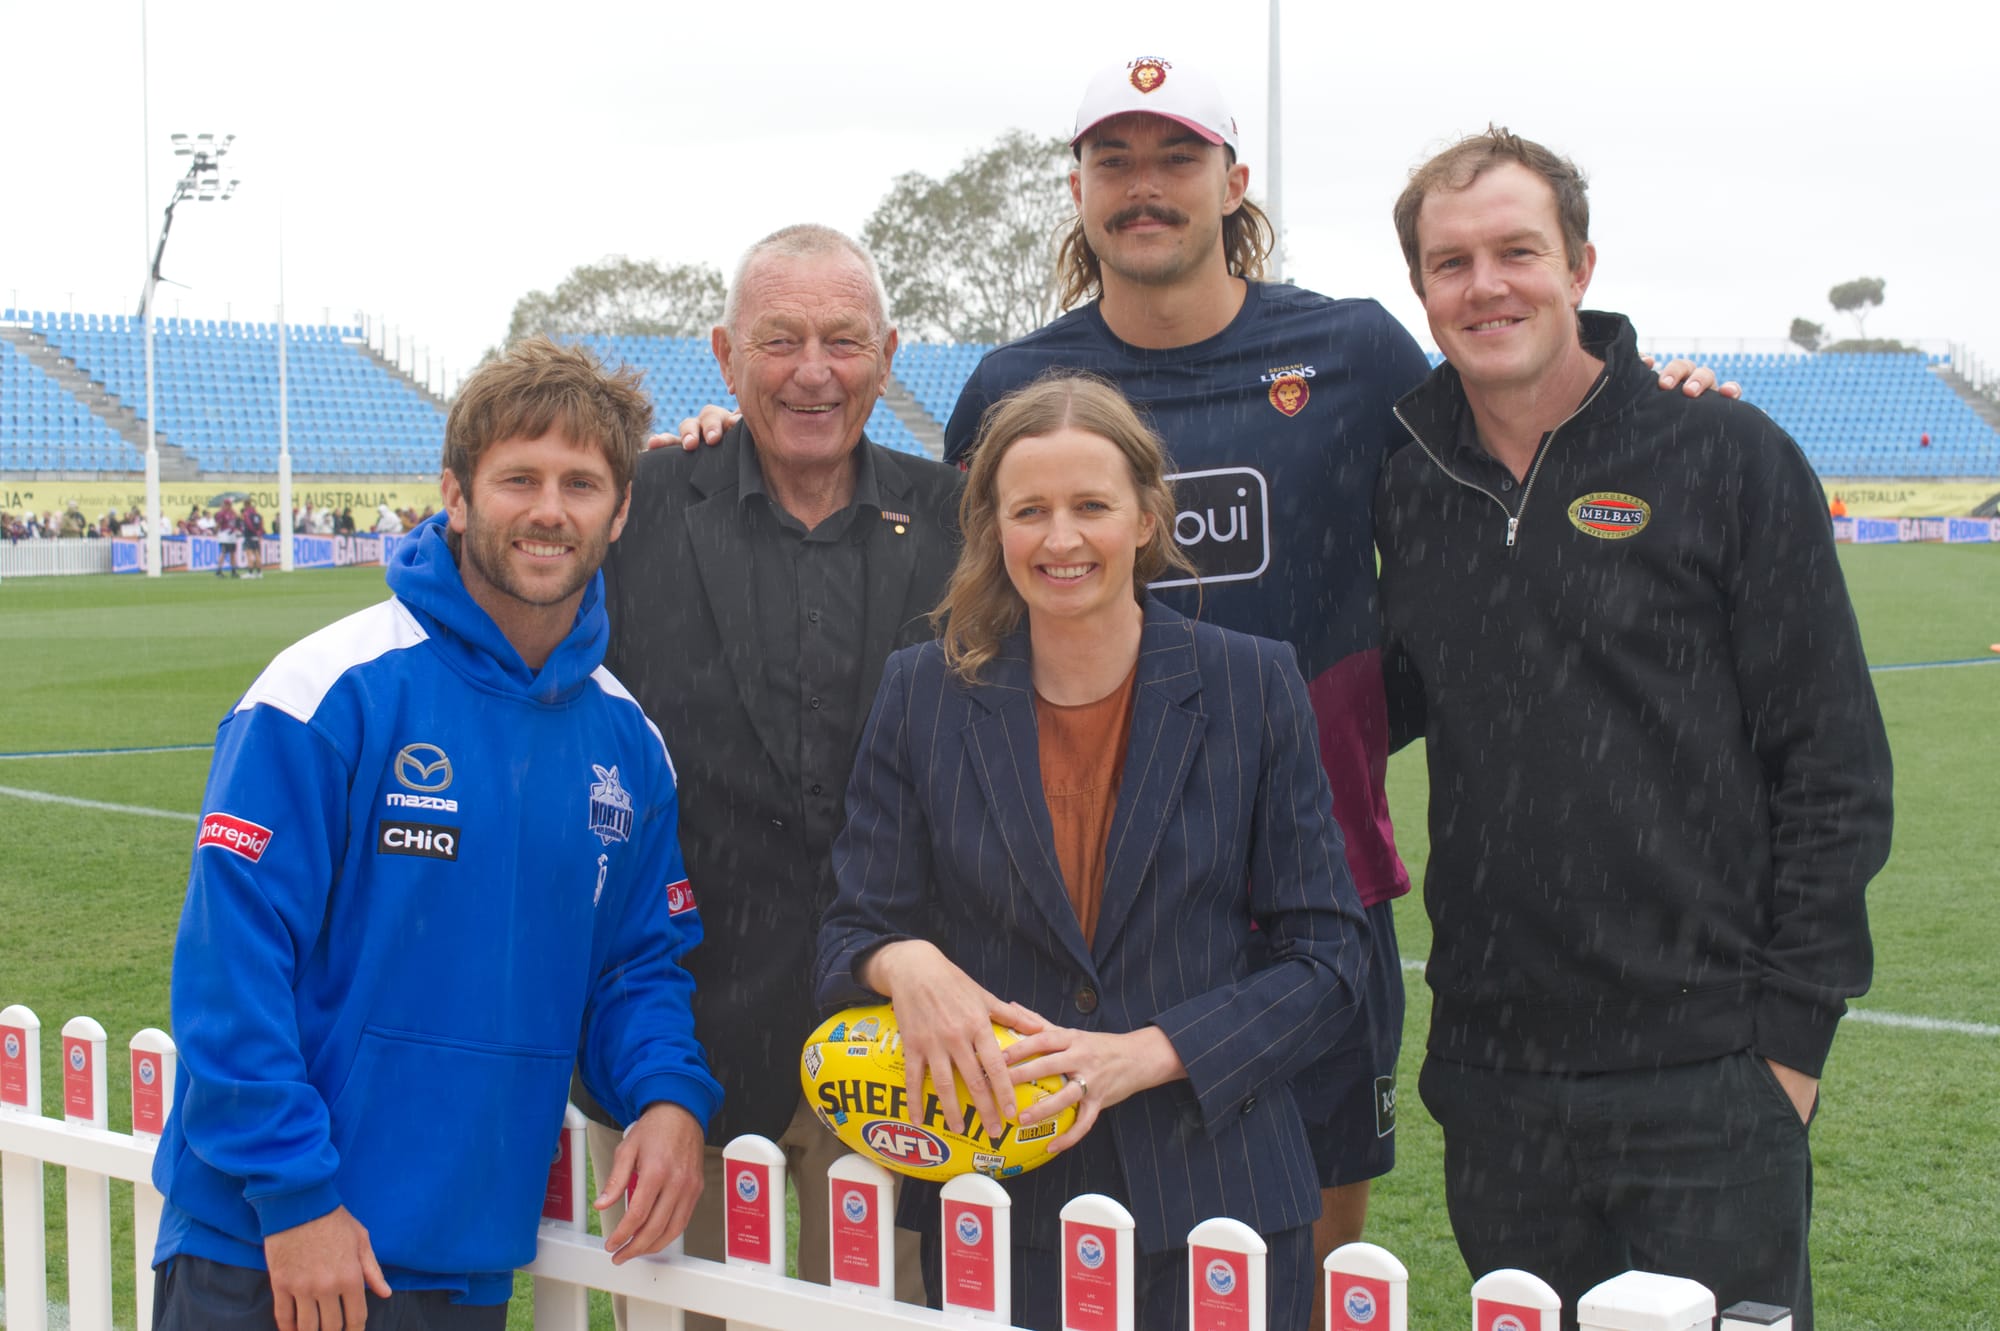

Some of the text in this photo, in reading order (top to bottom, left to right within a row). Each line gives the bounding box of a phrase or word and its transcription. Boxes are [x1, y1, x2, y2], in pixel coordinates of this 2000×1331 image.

[1260, 365, 1316, 382] LIONS
[250, 492, 389, 508] SOUH AUSTRALIA
[1581, 508, 1641, 523] MELBA'S
[1173, 487, 1248, 546] oui
[335, 534, 379, 566] GATHER
[591, 799, 632, 838] NORTH
[870, 1128, 943, 1163] AFL
